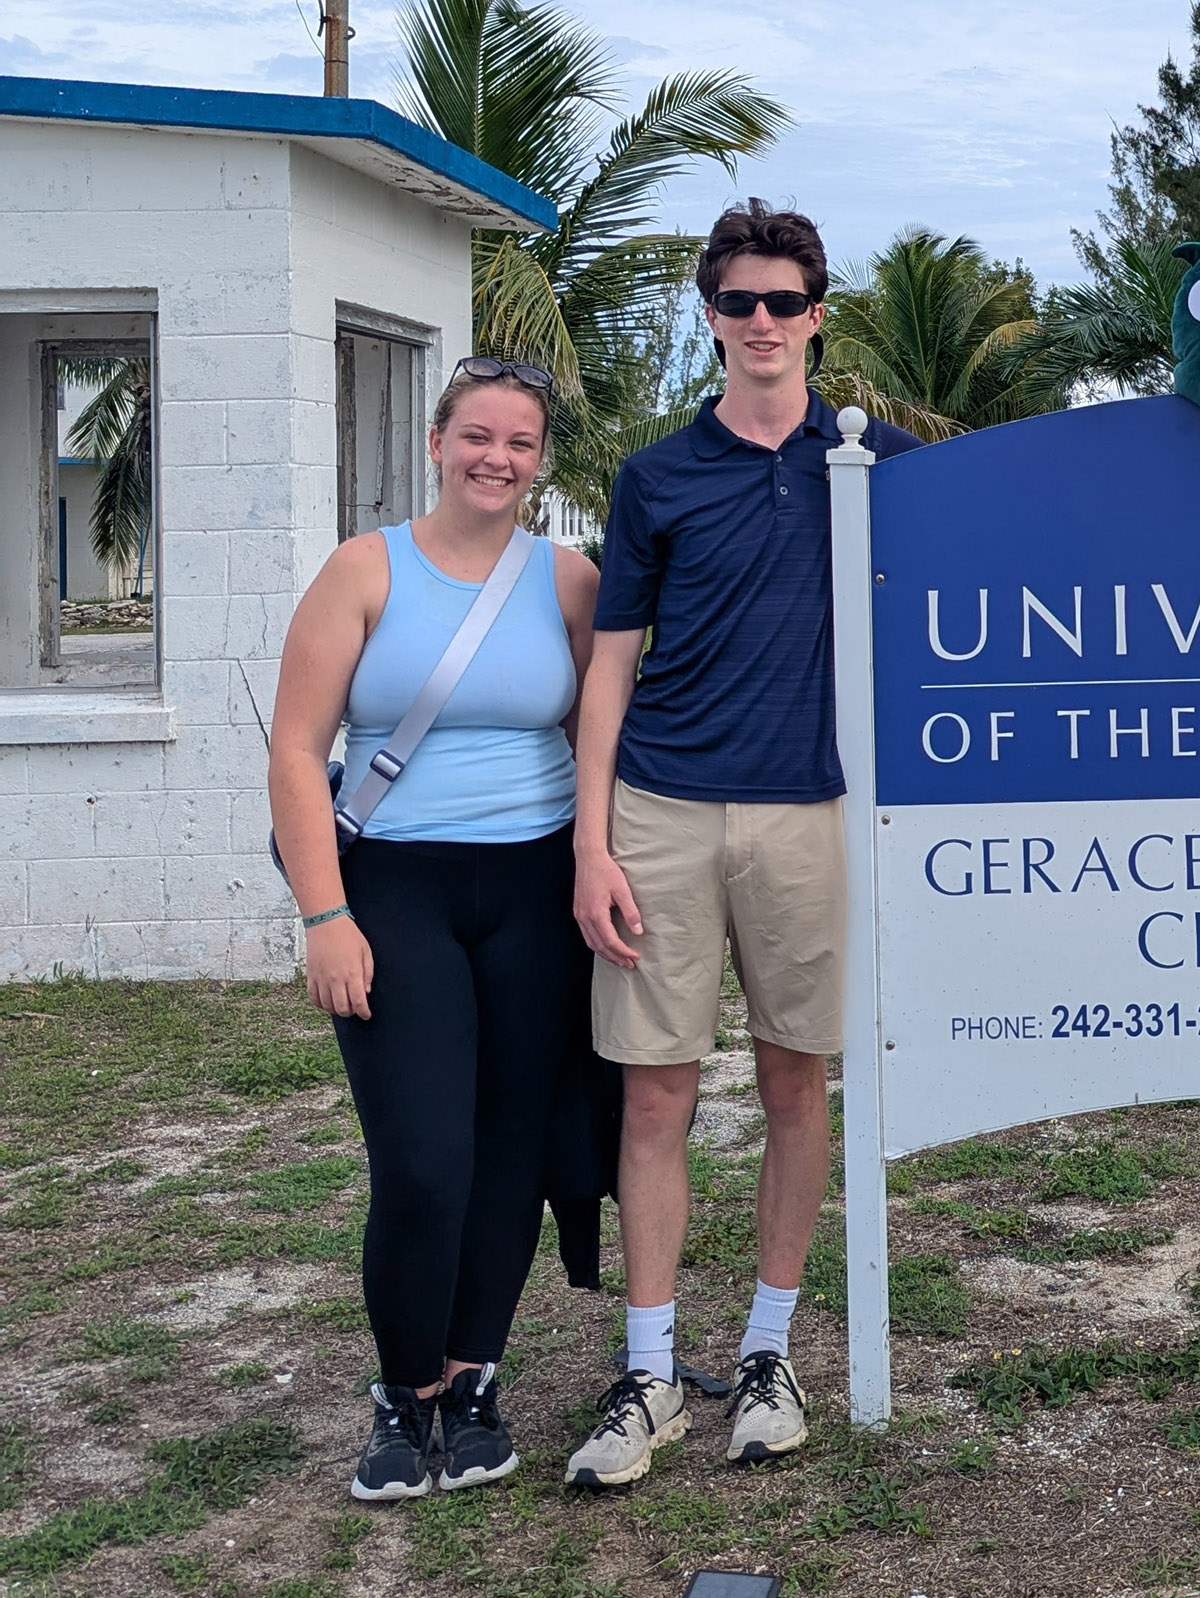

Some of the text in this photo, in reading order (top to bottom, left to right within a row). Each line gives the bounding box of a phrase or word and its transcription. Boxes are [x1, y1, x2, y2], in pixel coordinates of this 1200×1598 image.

[922, 711, 1015, 763] OF
[1057, 707, 1197, 759] THE
[951, 1015, 1044, 1041] PHONE:
